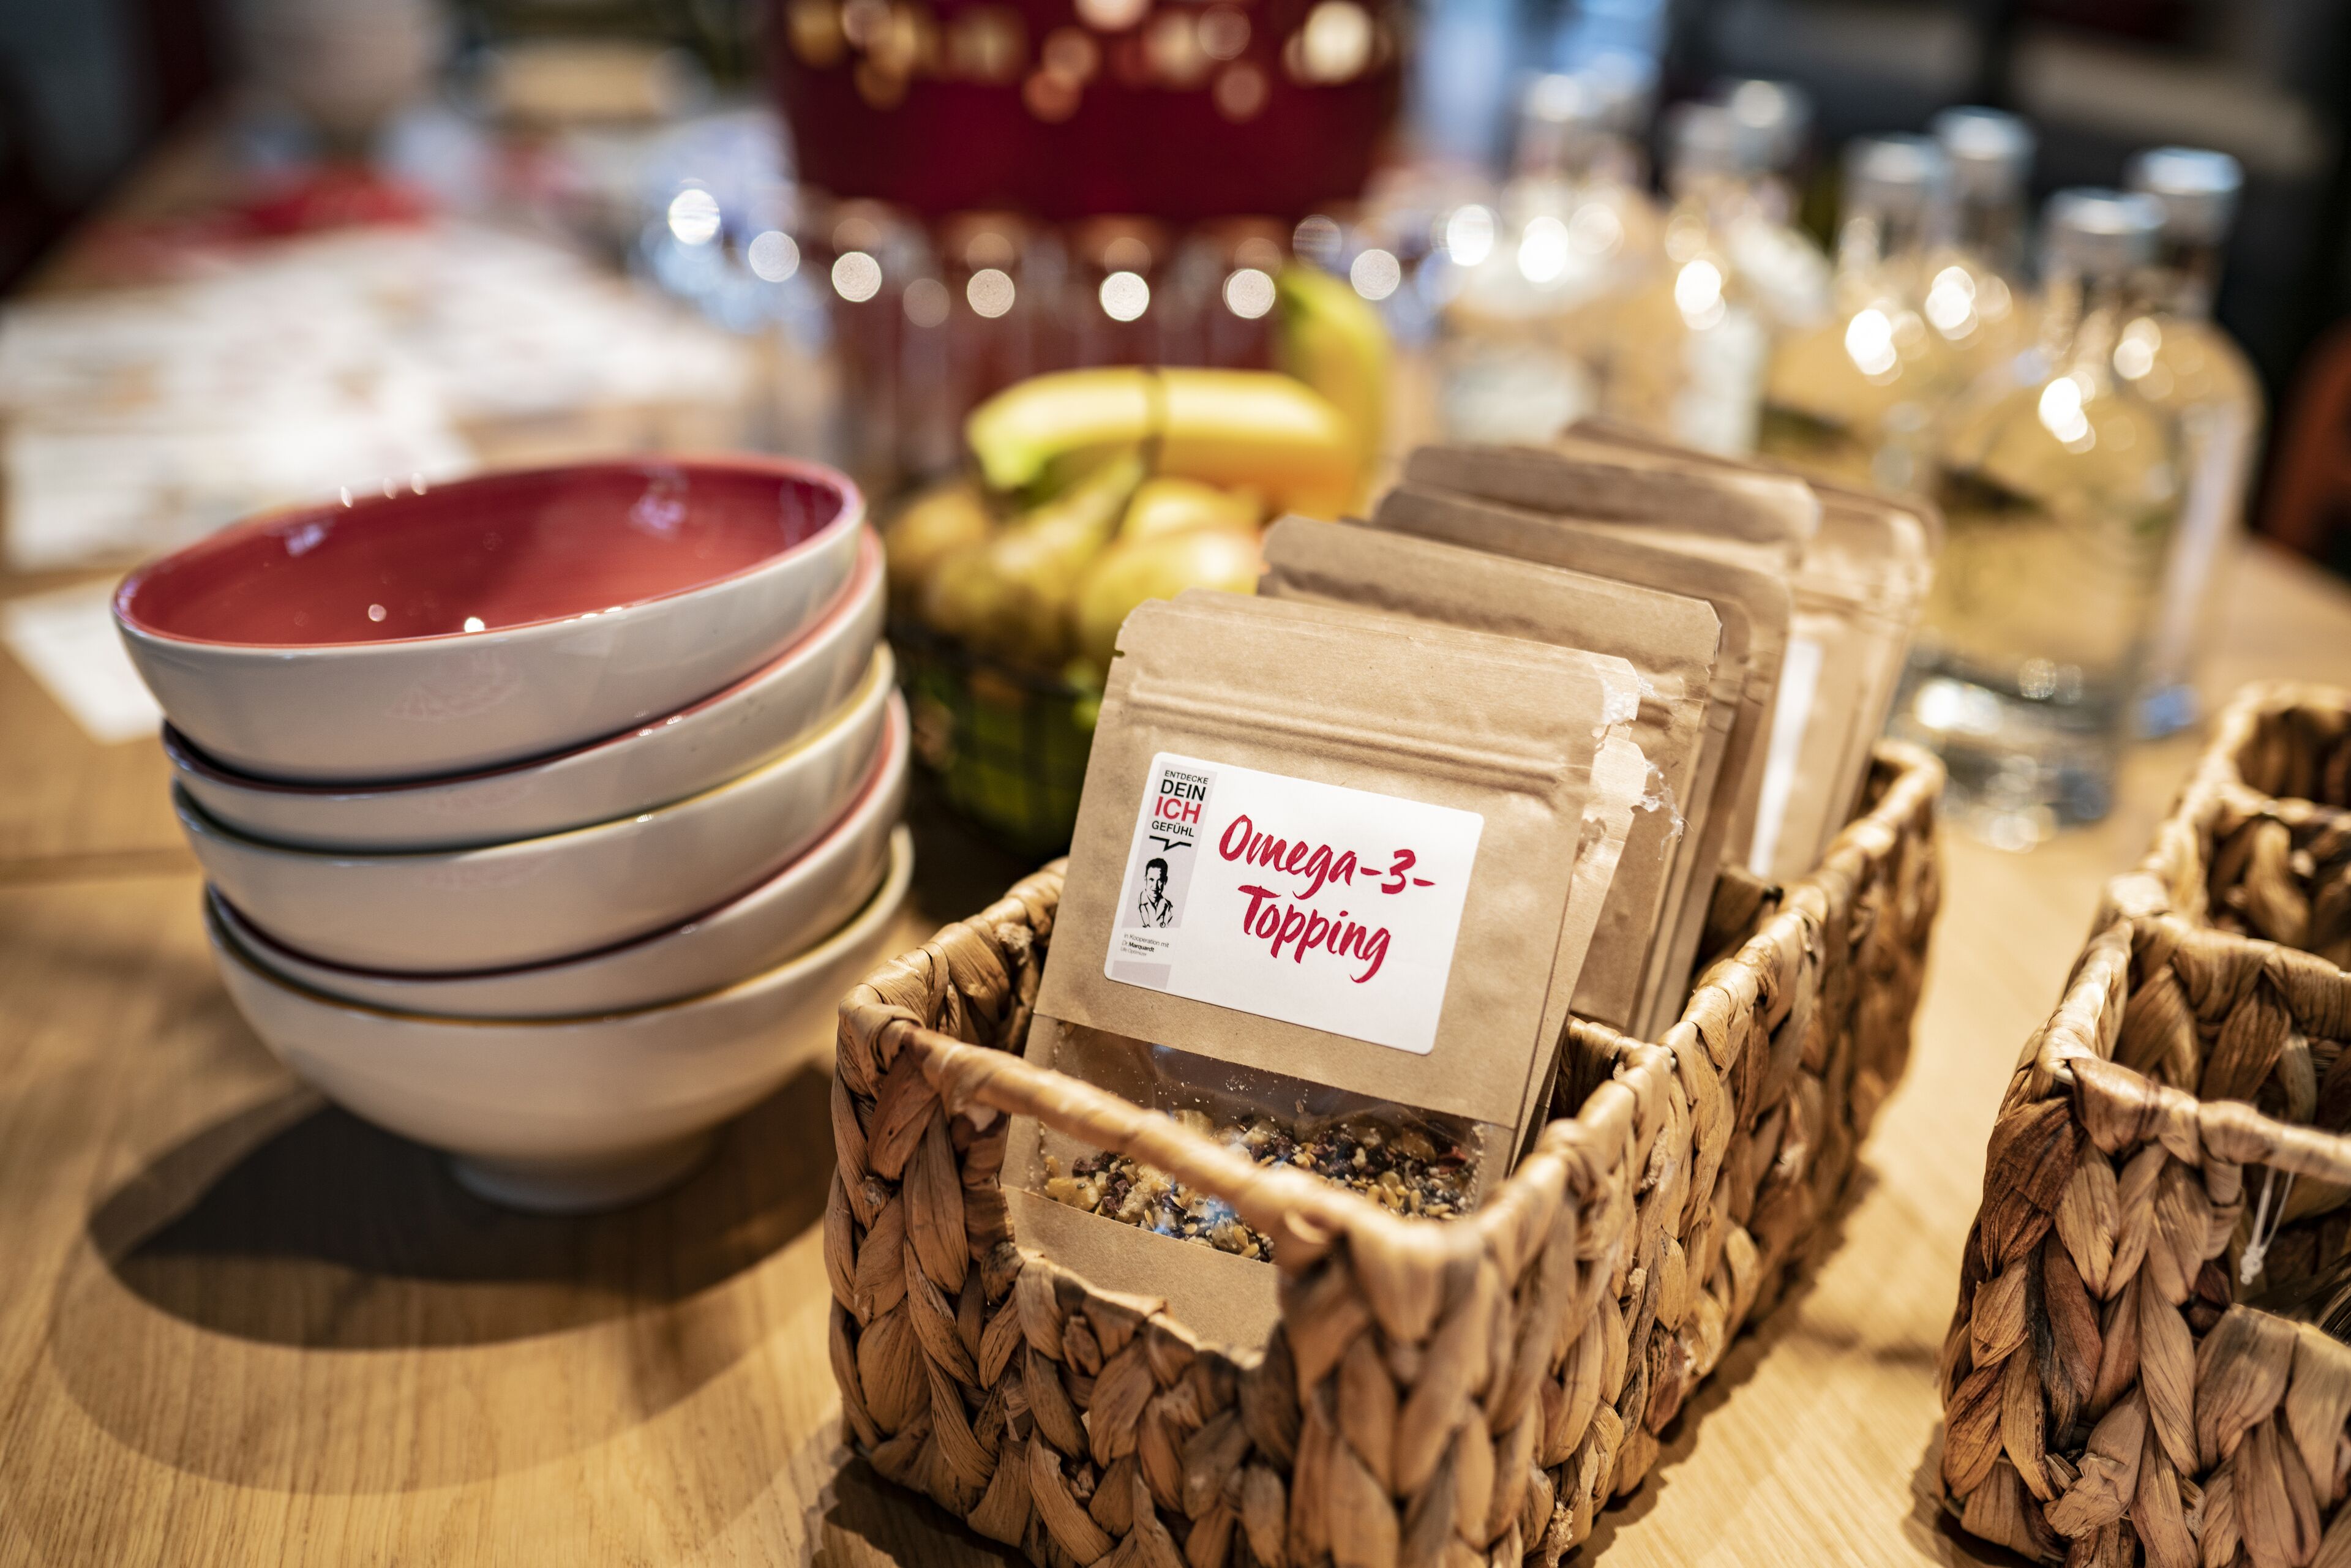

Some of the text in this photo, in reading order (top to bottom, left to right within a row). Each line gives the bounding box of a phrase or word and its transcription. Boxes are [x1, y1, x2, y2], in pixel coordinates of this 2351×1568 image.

[1164, 770, 1209, 784] ENTDECKE
[1160, 779, 1206, 801] DEIN
[1155, 796, 1202, 823] ICH
[1152, 820, 1194, 837] GEFÜHL
[1219, 814, 1436, 900] Omega-3-
[1130, 934, 1160, 946] Kooperation
[1237, 885, 1391, 983] Topping
[1128, 942, 1155, 952] Marquardt
